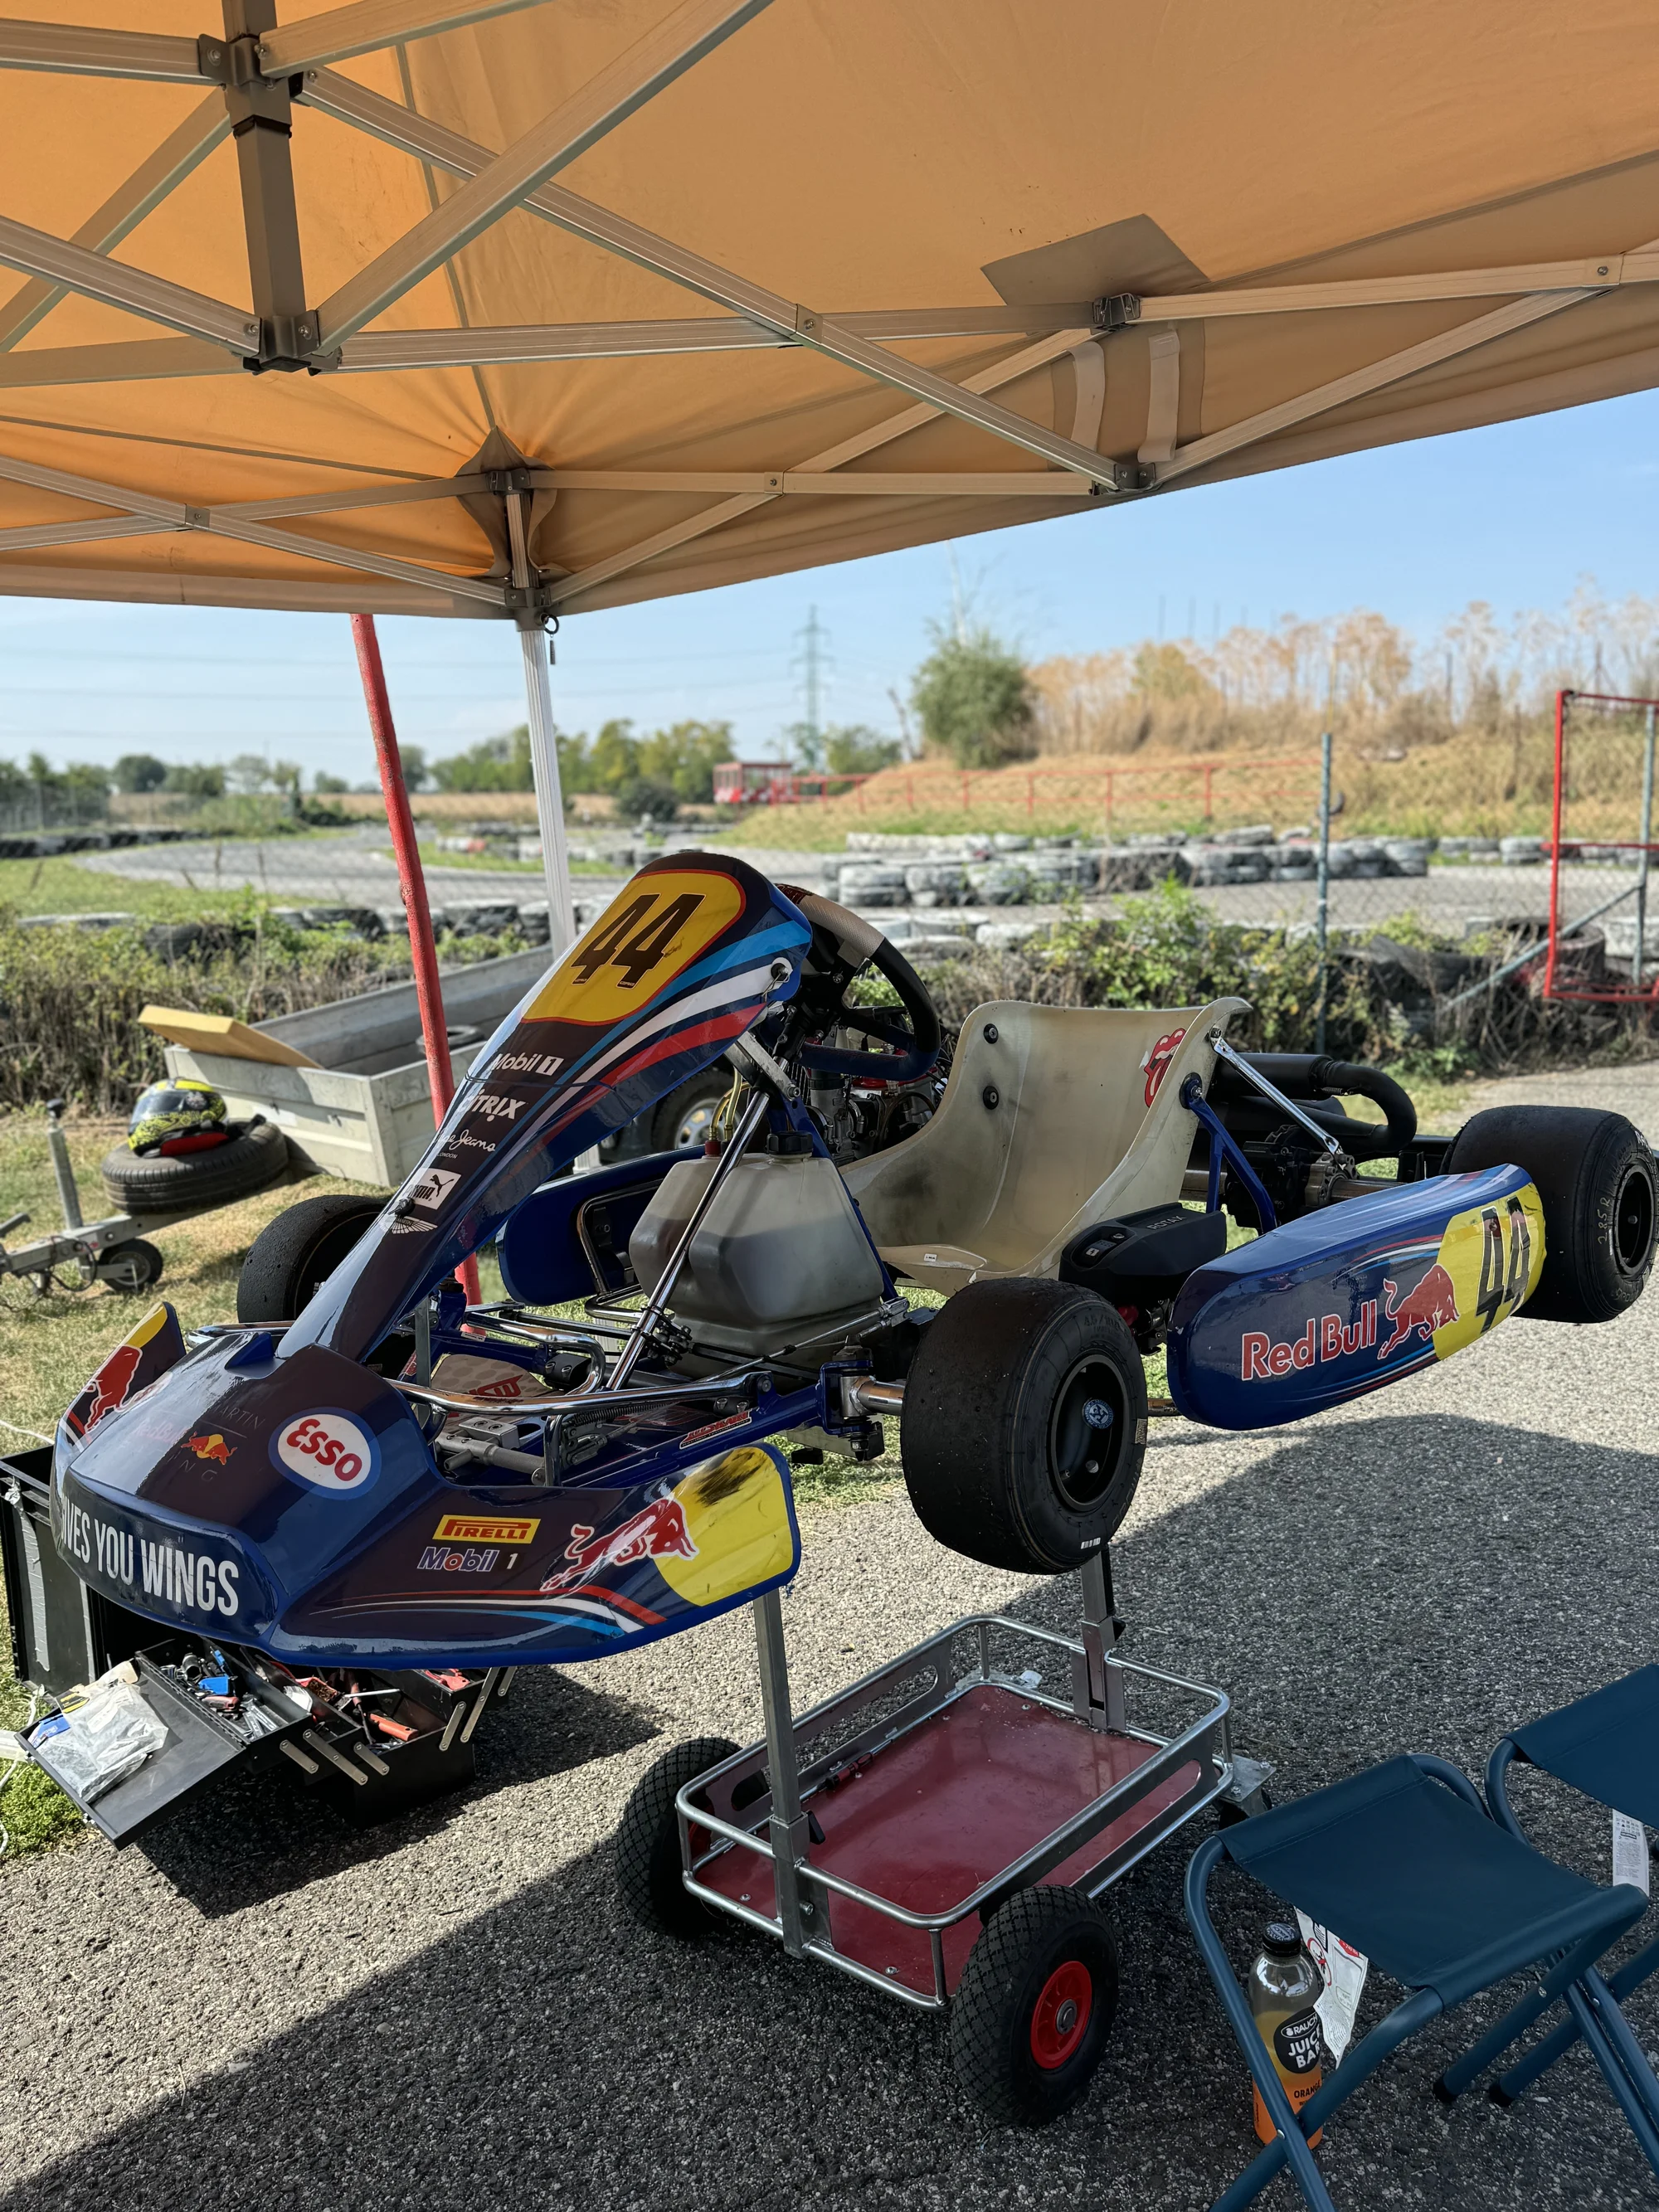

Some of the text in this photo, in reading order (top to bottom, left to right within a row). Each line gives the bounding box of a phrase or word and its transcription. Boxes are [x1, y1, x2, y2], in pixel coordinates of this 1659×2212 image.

[571, 892, 706, 989] 44
[491, 1052, 544, 1072] Mobil
[449, 1129, 496, 1152] Jeans
[1146, 1215, 1186, 1230] ROTAX
[1476, 1194, 1530, 1334] 44
[1242, 1298, 1377, 1381] Red Bull
[441, 1519, 532, 1539] PIRELLI
[94, 1518, 134, 1585] YOU
[140, 1539, 239, 1616] WINGS
[416, 1546, 518, 1572] Mobil 1
[1292, 2013, 1318, 2035] RAUCH
